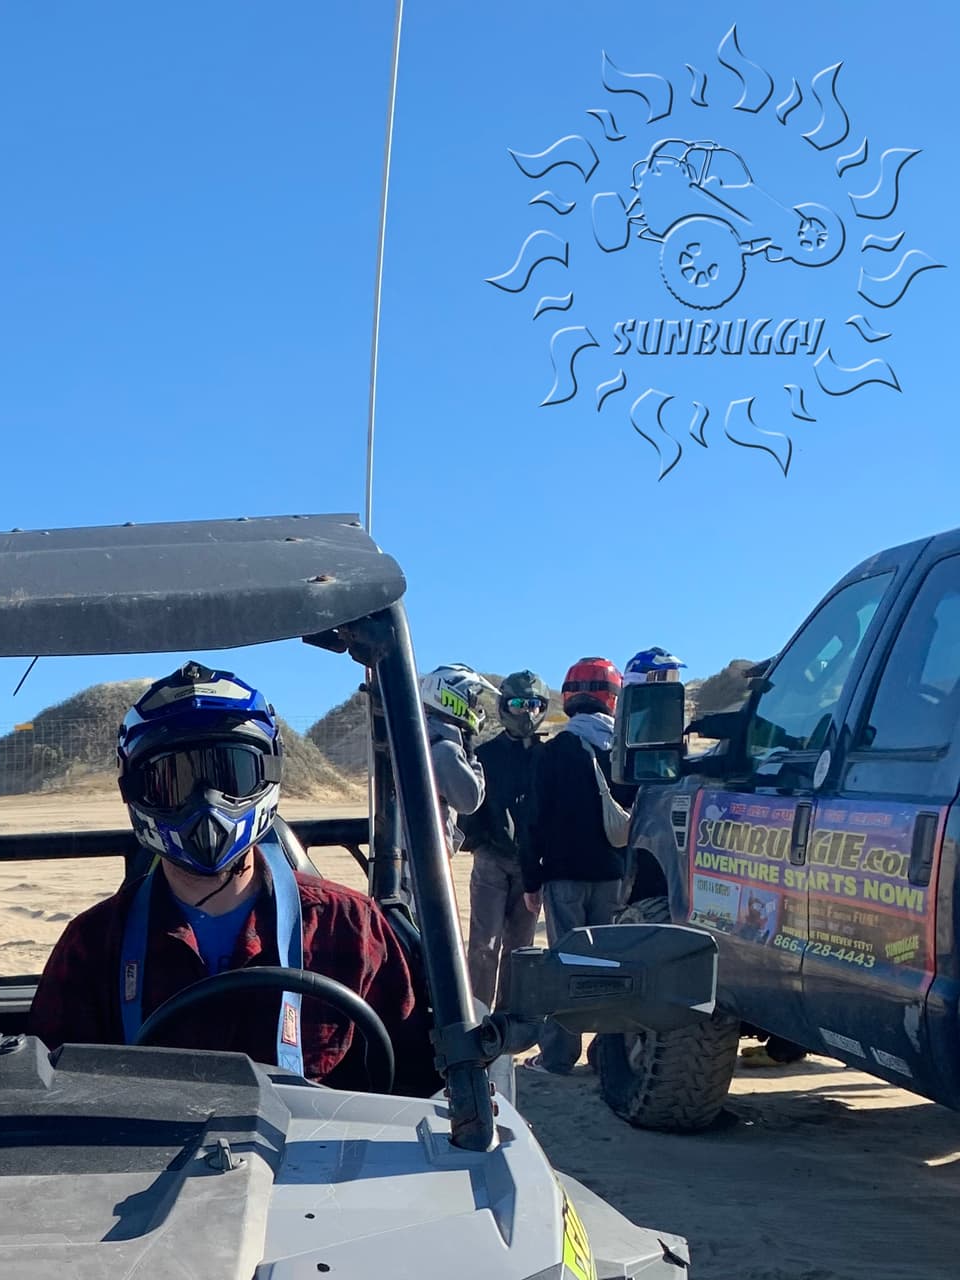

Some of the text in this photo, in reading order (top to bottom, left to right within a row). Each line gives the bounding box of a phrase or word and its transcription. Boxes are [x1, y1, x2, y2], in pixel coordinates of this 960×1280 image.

[694, 851, 780, 884] ADVENTURE
[784, 869, 858, 897] STARTS
[863, 879, 924, 912] NOW!
[773, 934, 876, 968] 866-728-4443
